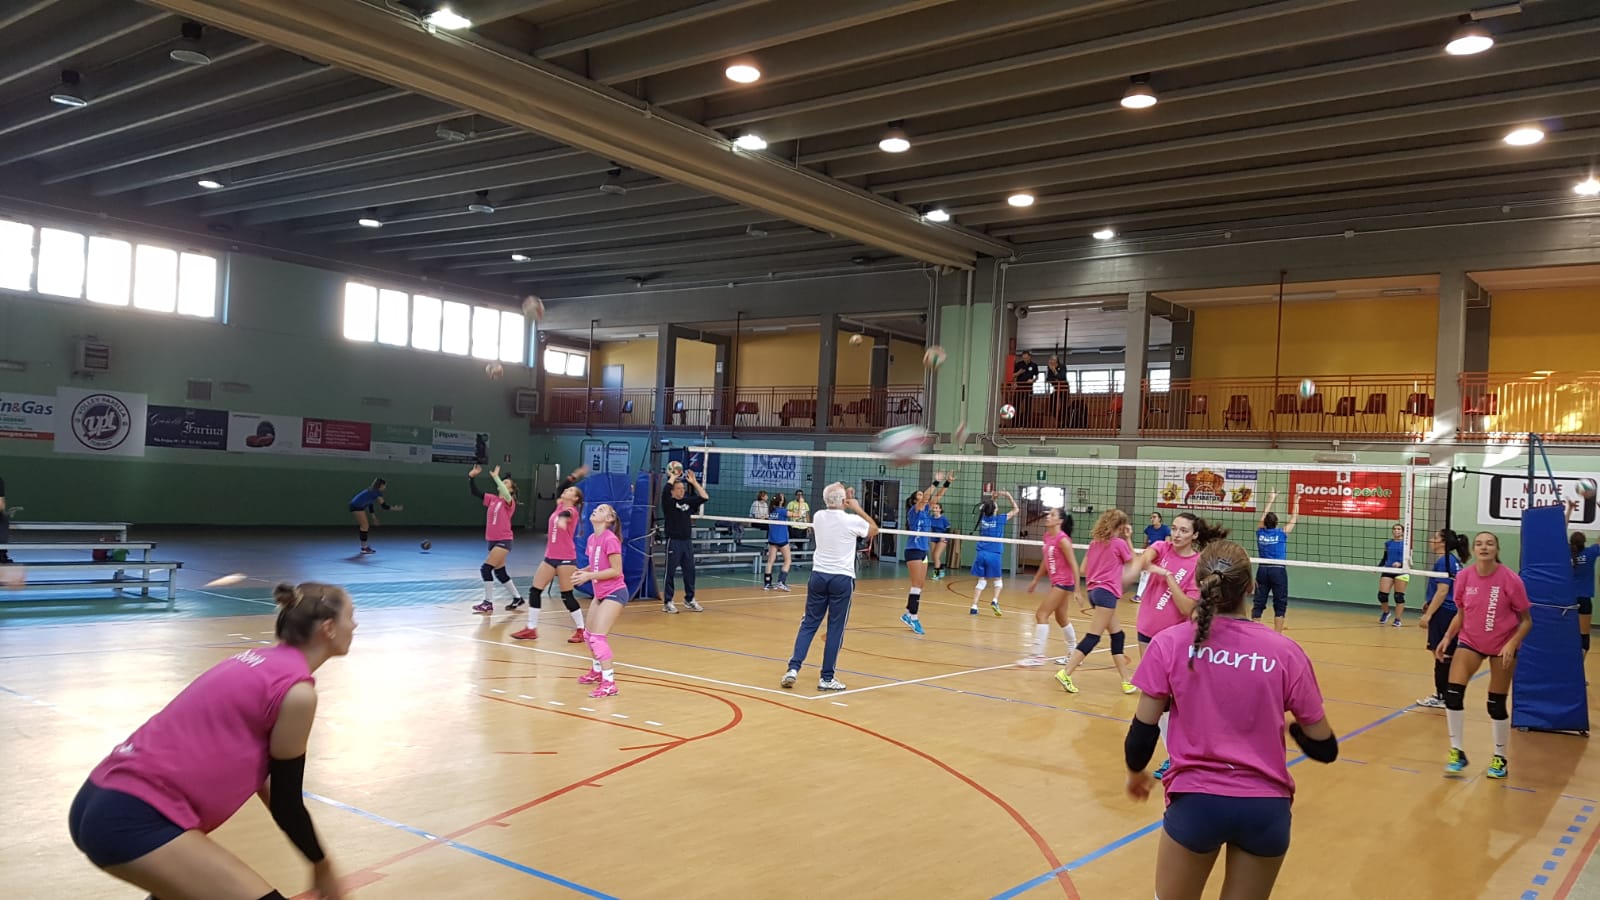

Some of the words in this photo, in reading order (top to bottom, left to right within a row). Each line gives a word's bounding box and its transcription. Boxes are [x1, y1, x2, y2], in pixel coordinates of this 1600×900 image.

[182, 420, 224, 436] Farina
[767, 461, 797, 471] BANCO
[749, 469, 797, 480] AZZOAGLIO
[1188, 644, 1277, 673] martu
